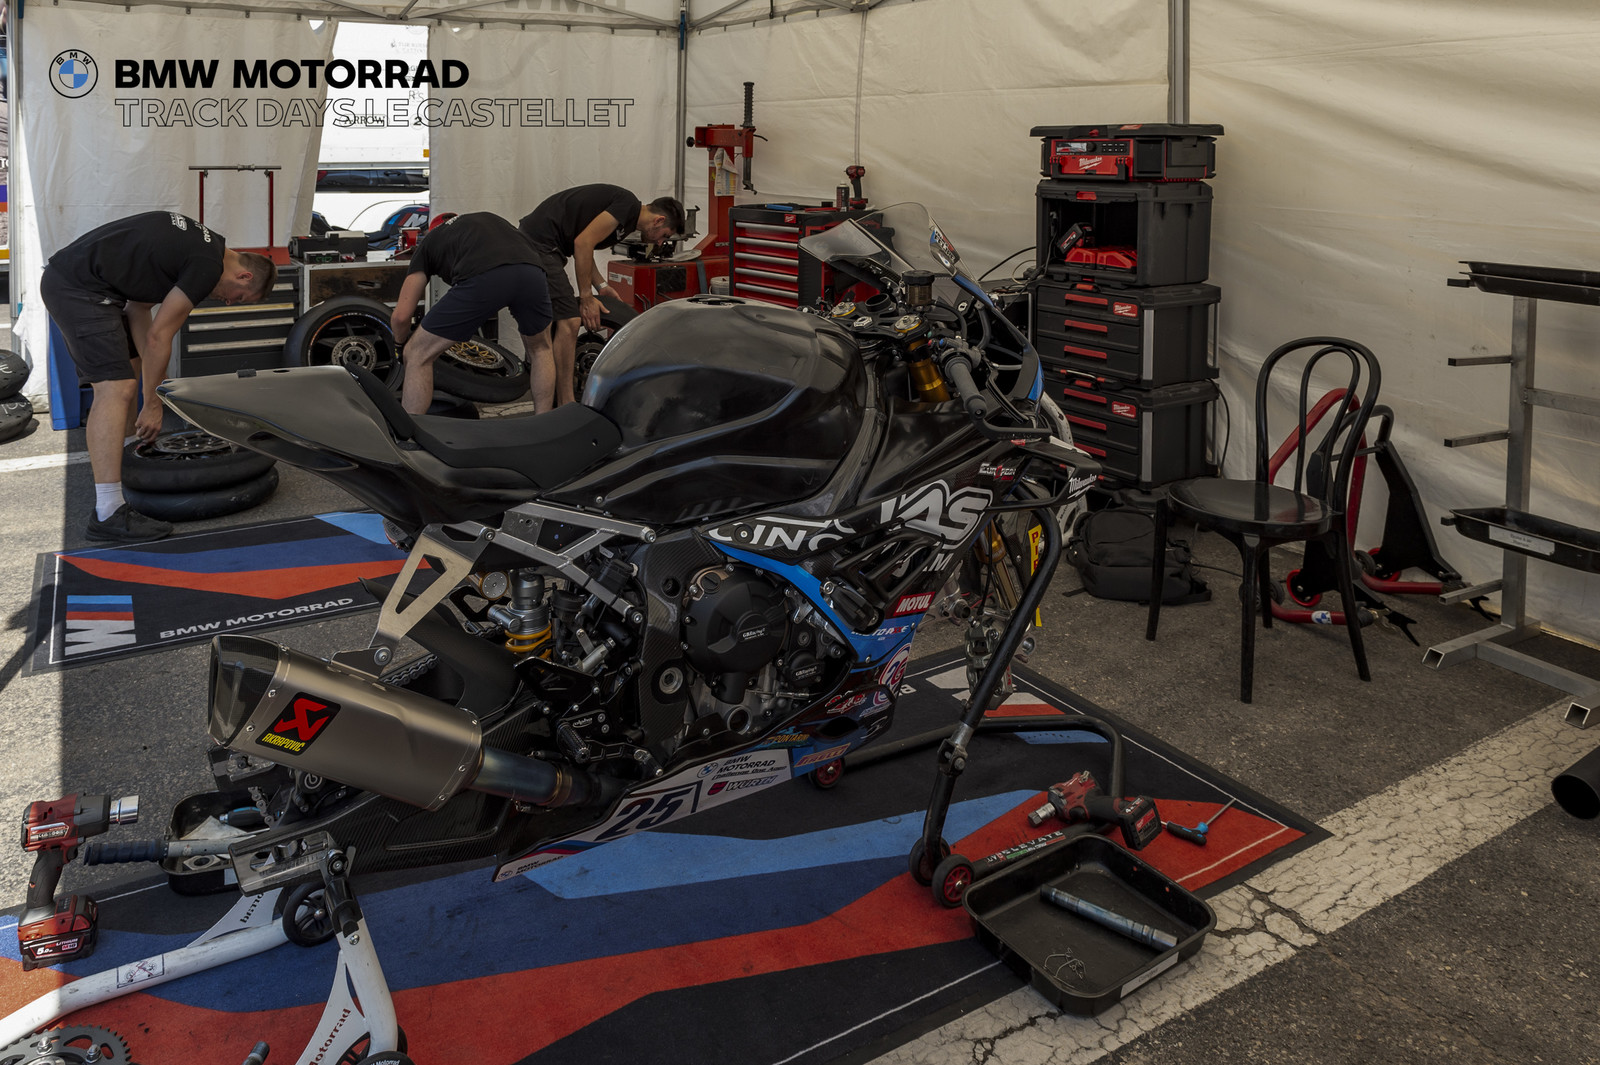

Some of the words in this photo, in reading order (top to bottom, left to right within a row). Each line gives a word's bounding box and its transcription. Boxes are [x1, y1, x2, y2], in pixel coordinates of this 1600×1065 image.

[896, 594, 931, 613] MOTUL
[159, 621, 222, 639] BMW
[226, 597, 354, 627] MOTORRAD
[717, 760, 776, 774] MOTORRAD
[723, 755, 752, 766] BMW
[593, 787, 697, 841] 25
[517, 860, 540, 871] BMW
